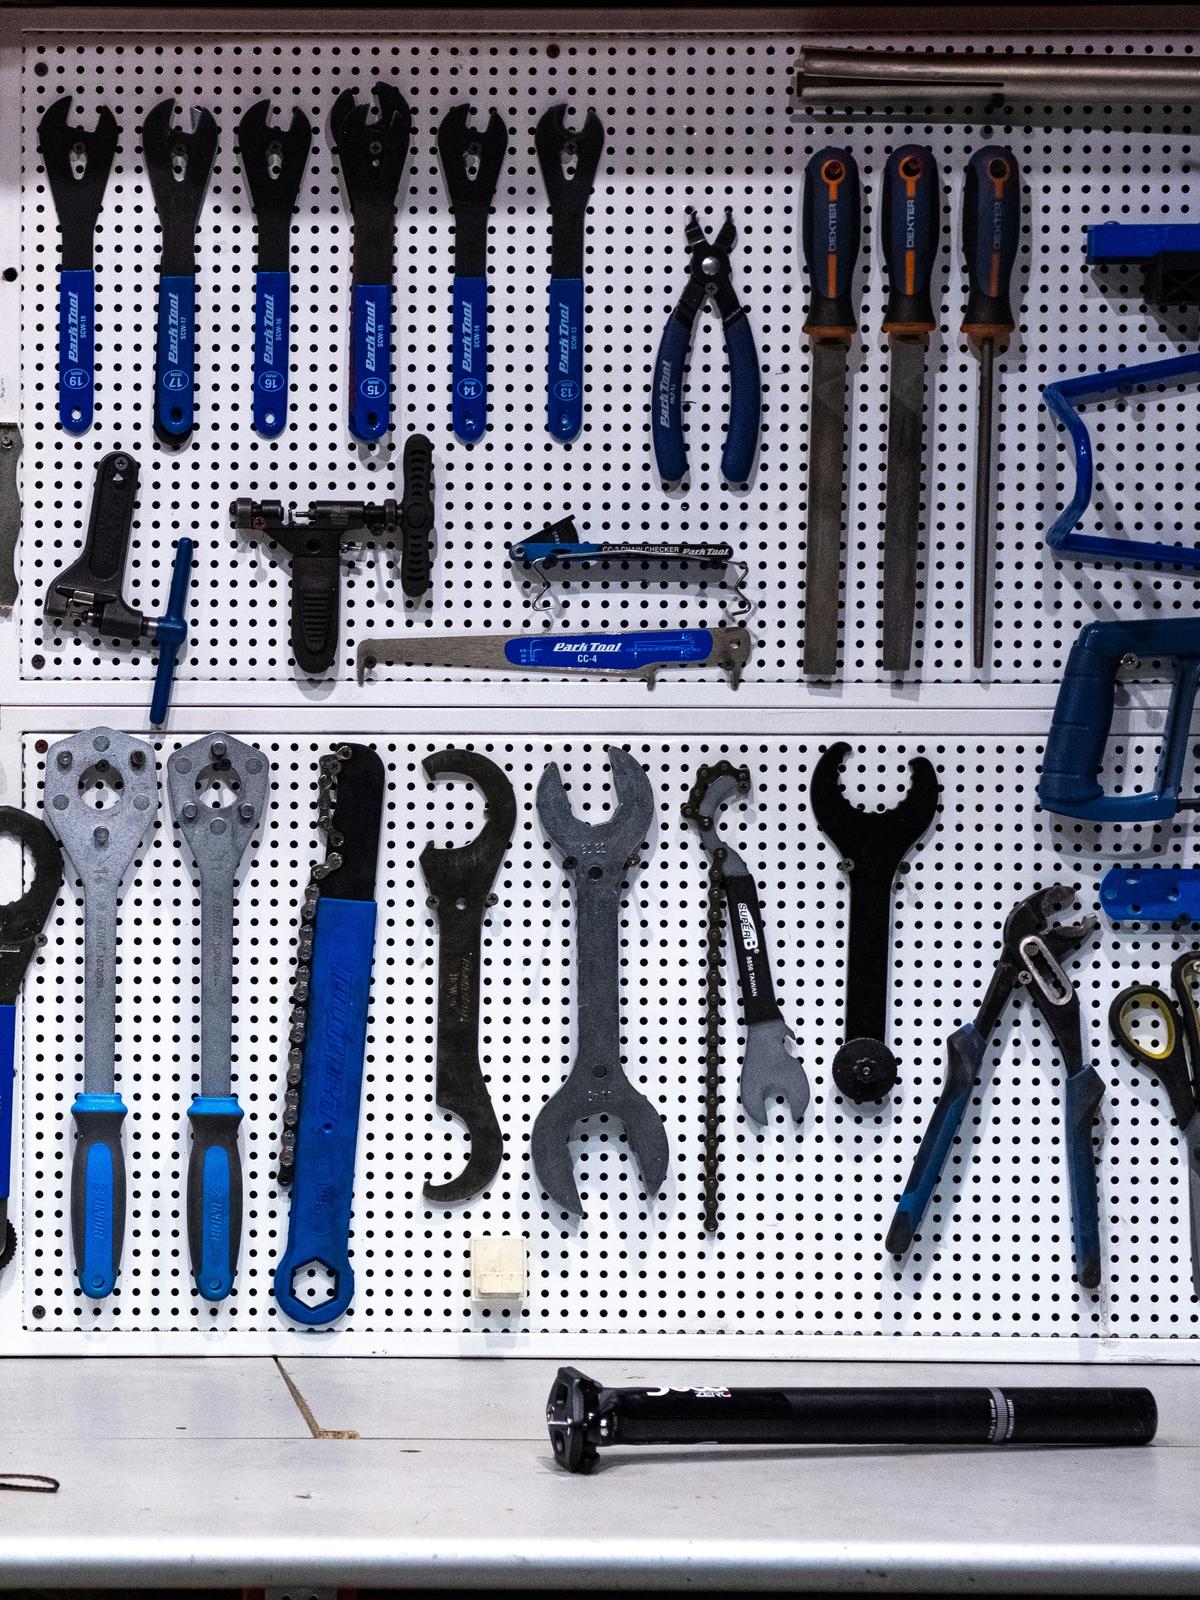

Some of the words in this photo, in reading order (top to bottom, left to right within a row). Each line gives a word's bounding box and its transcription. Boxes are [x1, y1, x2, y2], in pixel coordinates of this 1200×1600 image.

[828, 202, 837, 252] DEXTER
[906, 199, 915, 249] DEXTER
[993, 201, 1002, 250] DEXTER
[69, 376, 83, 387] 19
[169, 377, 183, 388] 17
[264, 379, 278, 389] 16
[367, 385, 380, 395] 15
[463, 386, 476, 396] 14
[560, 388, 574, 397] 13
[644, 545, 680, 554] CHECKER
[552, 642, 589, 652] Park
[588, 642, 622, 652] Tool
[577, 654, 598, 663] CC-4
[748, 972, 758, 997] TAIWAN
